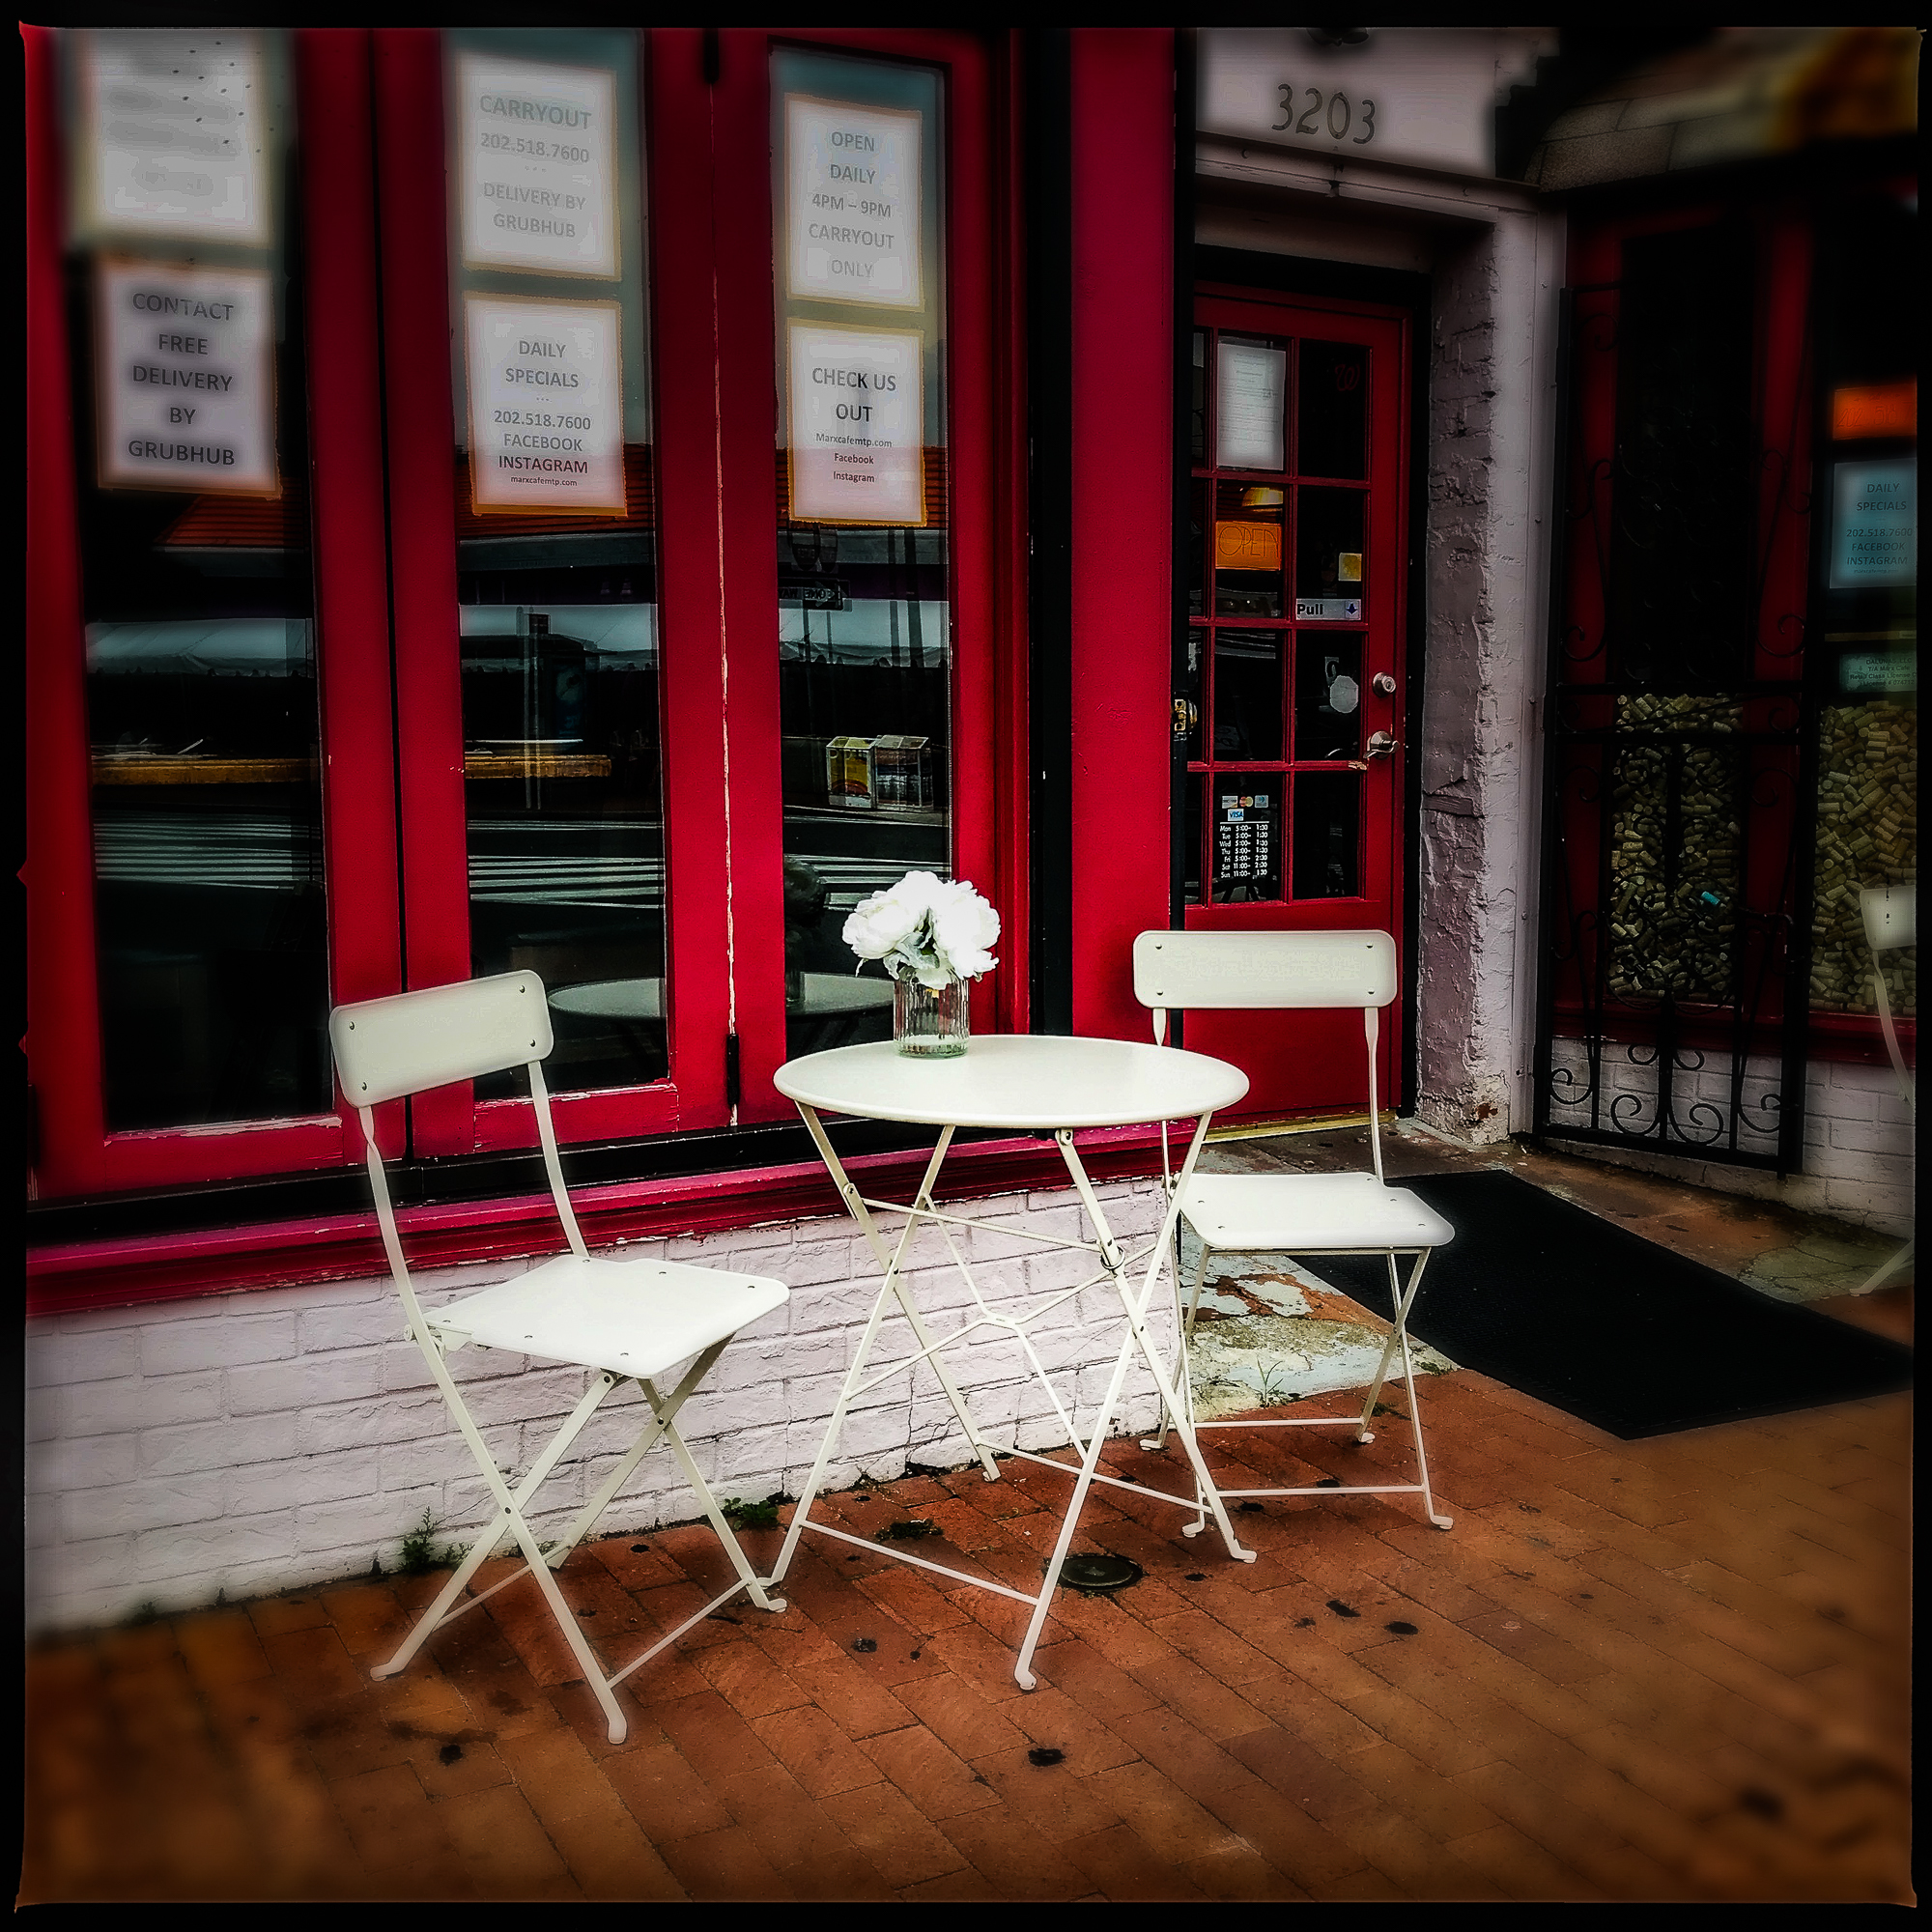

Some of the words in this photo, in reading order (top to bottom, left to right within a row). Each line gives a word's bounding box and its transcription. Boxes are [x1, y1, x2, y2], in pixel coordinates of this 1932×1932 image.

[479, 95, 592, 129] CARRYOUT
[1271, 83, 1376, 144] 3203
[480, 132, 589, 163] 202.518.7600
[831, 130, 875, 153] OPEN
[830, 163, 876, 185] DAILY
[483, 182, 561, 207] DELIVERY
[565, 194, 586, 211] BY
[811, 193, 844, 211] 4PM
[860, 200, 892, 218] 9PM
[493, 213, 576, 238] GRUBHUB
[808, 222, 895, 250] CARRYOUT
[831, 259, 875, 278] ONLY
[131, 292, 235, 322] CONTACT
[157, 332, 209, 355] FREE
[519, 339, 567, 358] DAILY
[131, 364, 235, 393] DELIVERY
[505, 367, 580, 388] SPECIALS
[811, 367, 869, 390] CHECK
[873, 373, 896, 392] US
[169, 406, 197, 425] BY
[494, 410, 591, 431] 202.518.7600
[836, 403, 873, 423] OUT
[503, 433, 583, 452] FACEBOOK
[815, 432, 893, 448] Marxcafemtp.com
[128, 440, 236, 466] GRUBHUB
[834, 452, 874, 465] Facebook
[498, 455, 589, 474] INSTAGRAM
[510, 476, 578, 487] marxcafemtp.com
[833, 470, 875, 483] Instagram
[1866, 483, 1900, 494] DAILY
[1856, 500, 1907, 512] SPECIALS
[1218, 526, 1279, 558] OPEN
[1846, 528, 1913, 538] 202.518.7600
[1852, 542, 1906, 552] FACEBOOK
[1847, 556, 1908, 566] INSTAGRAM
[1296, 604, 1324, 615] Pull
